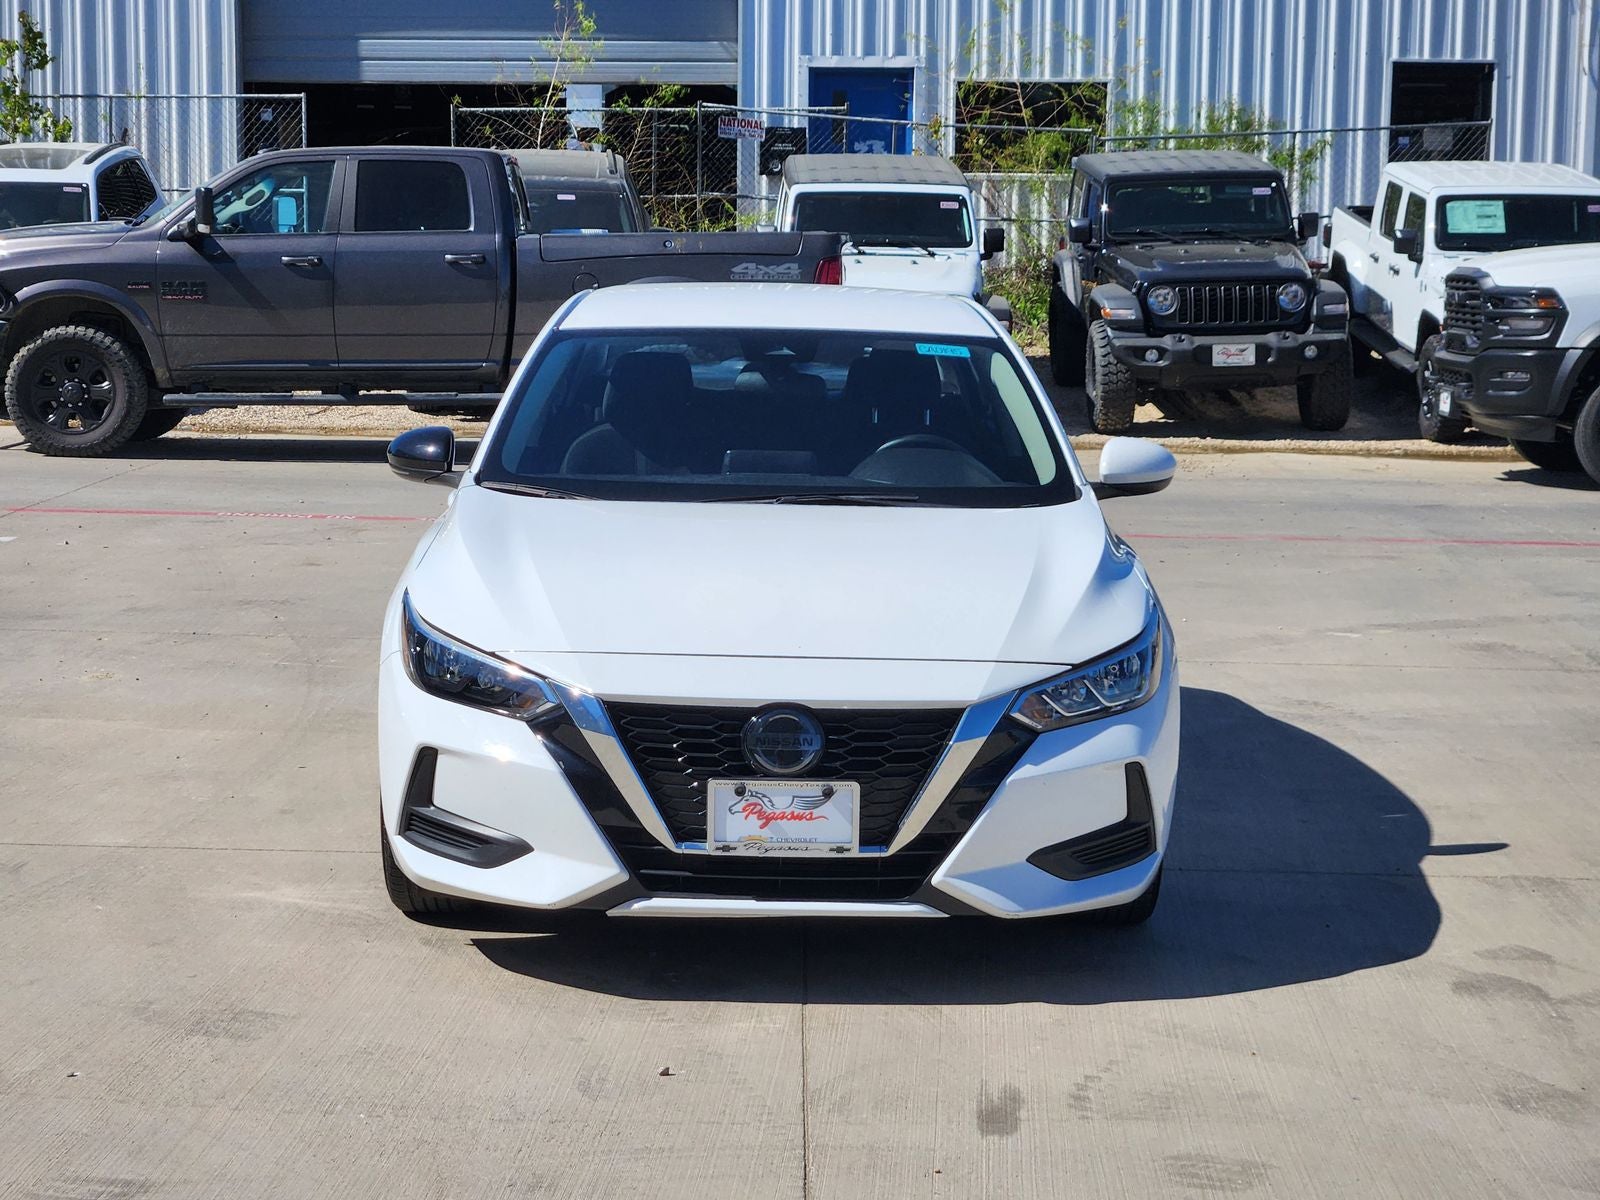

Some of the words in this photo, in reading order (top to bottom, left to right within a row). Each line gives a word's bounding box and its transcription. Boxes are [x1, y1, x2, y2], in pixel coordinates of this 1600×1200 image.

[719, 117, 764, 130] NATIONAL
[731, 262, 802, 275] 4x4
[755, 736, 814, 746] NISSAN
[742, 802, 829, 829] Pegasus
